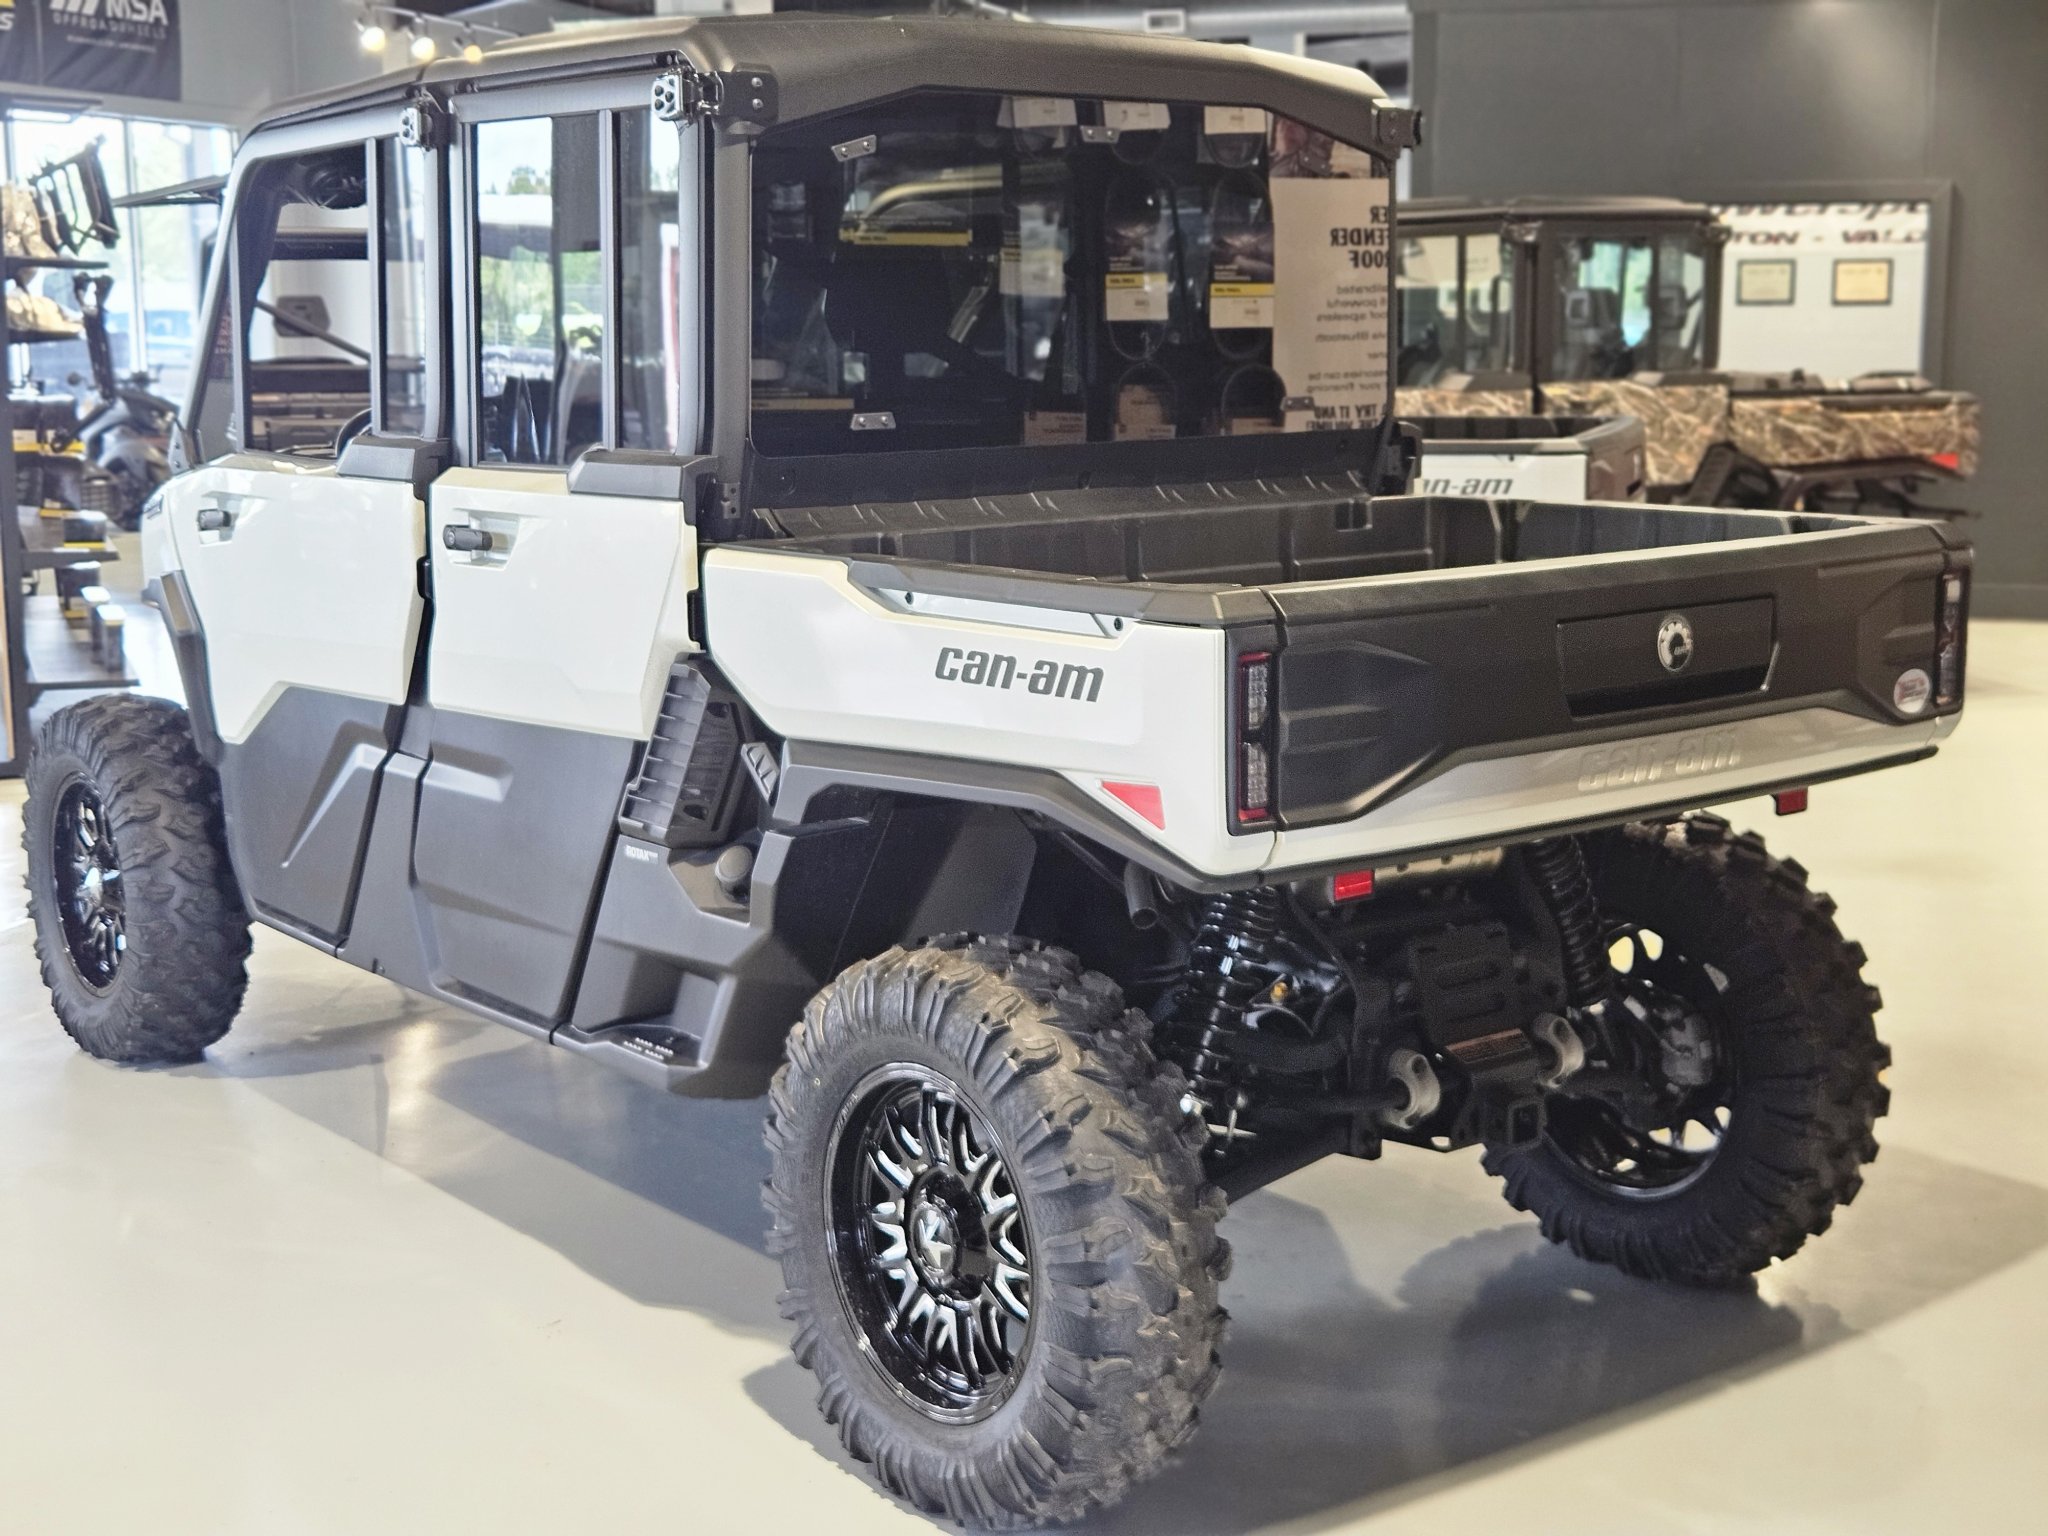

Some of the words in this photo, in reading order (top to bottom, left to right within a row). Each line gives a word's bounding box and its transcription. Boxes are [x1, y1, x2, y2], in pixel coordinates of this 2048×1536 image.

[106, 0, 169, 26] MSA
[935, 646, 1104, 703] can-am
[1577, 731, 1741, 791] can-am
[625, 844, 650, 862] ROTAX
